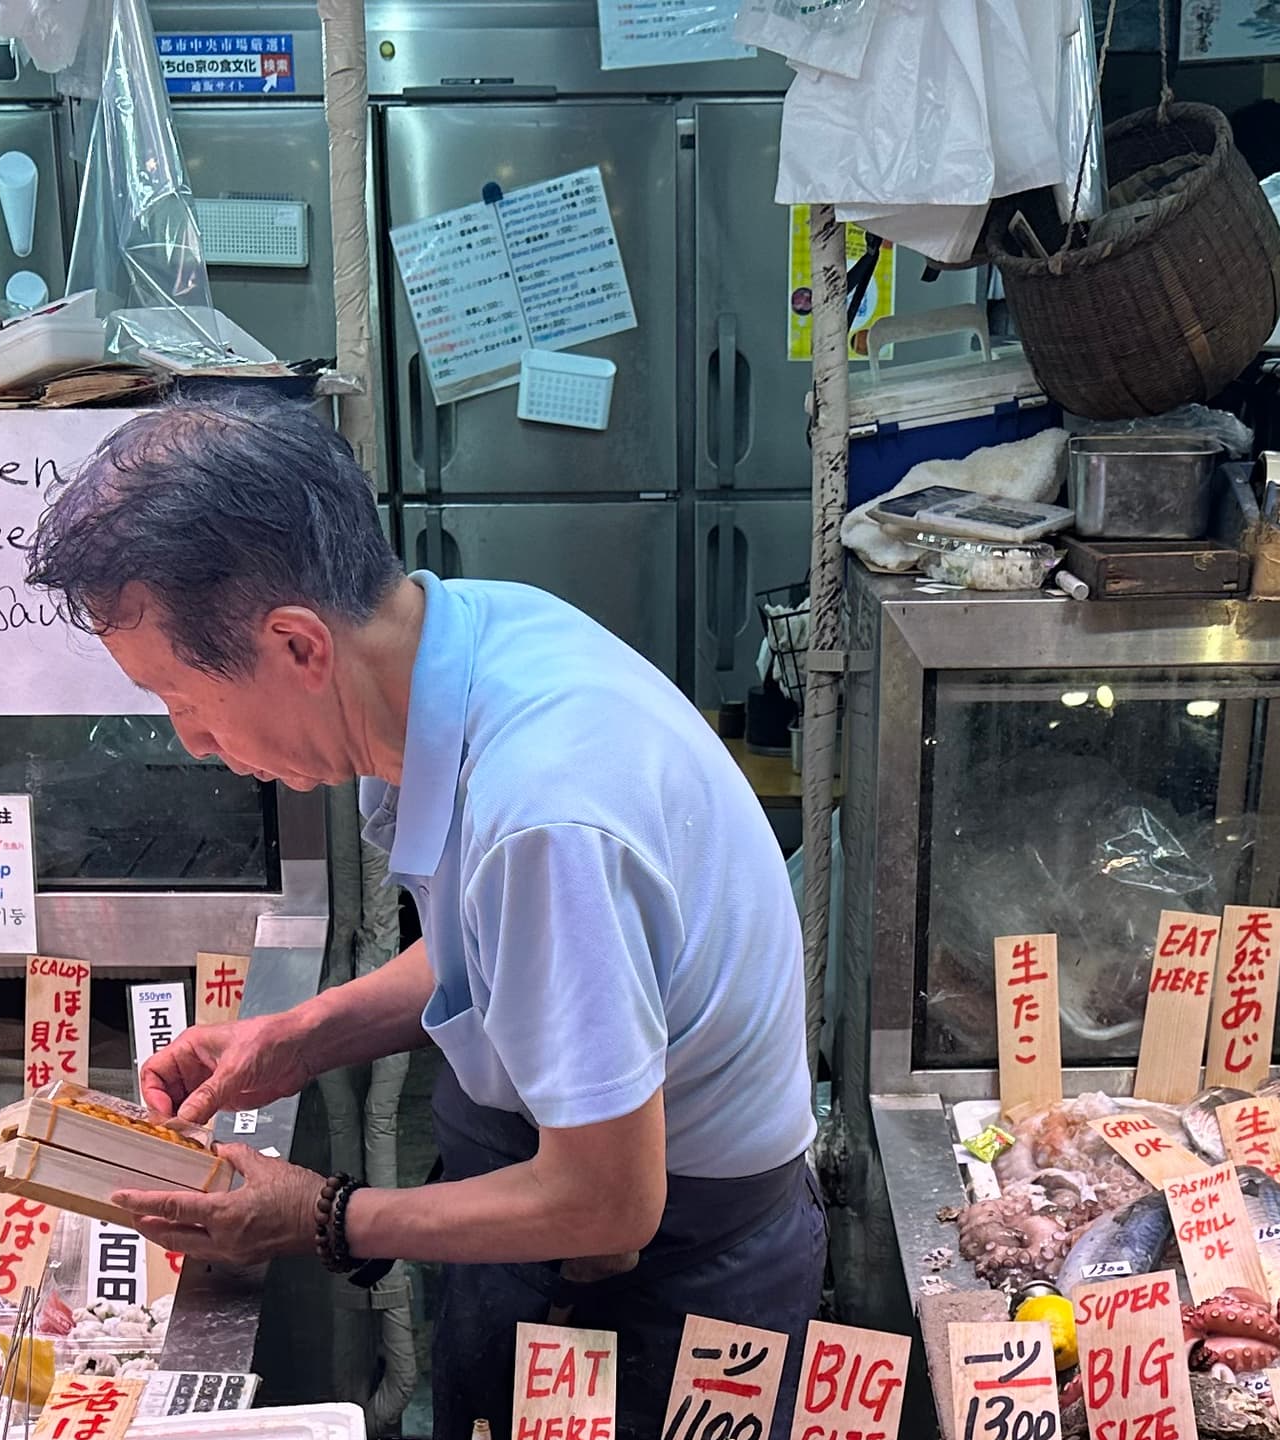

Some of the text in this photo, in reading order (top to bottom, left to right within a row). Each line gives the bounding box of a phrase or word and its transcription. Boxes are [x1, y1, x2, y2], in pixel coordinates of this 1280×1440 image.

[1159, 924, 1218, 958] EAT
[138, 990, 173, 1002] 550yen
[1150, 967, 1211, 997] HERE
[1222, 913, 1273, 1073] 天然あじ
[1006, 941, 1048, 1065] 生たこ
[1102, 1119, 1158, 1139] GRILL
[1135, 1137, 1173, 1158] OK
[1168, 1169, 1232, 1199] SASHIMI
[1178, 1212, 1236, 1242] GRILL
[1075, 1281, 1171, 1330] SUPER
[527, 1341, 611, 1400] EAT
[804, 1340, 902, 1423] BIG
[1087, 1337, 1175, 1411] BIG
